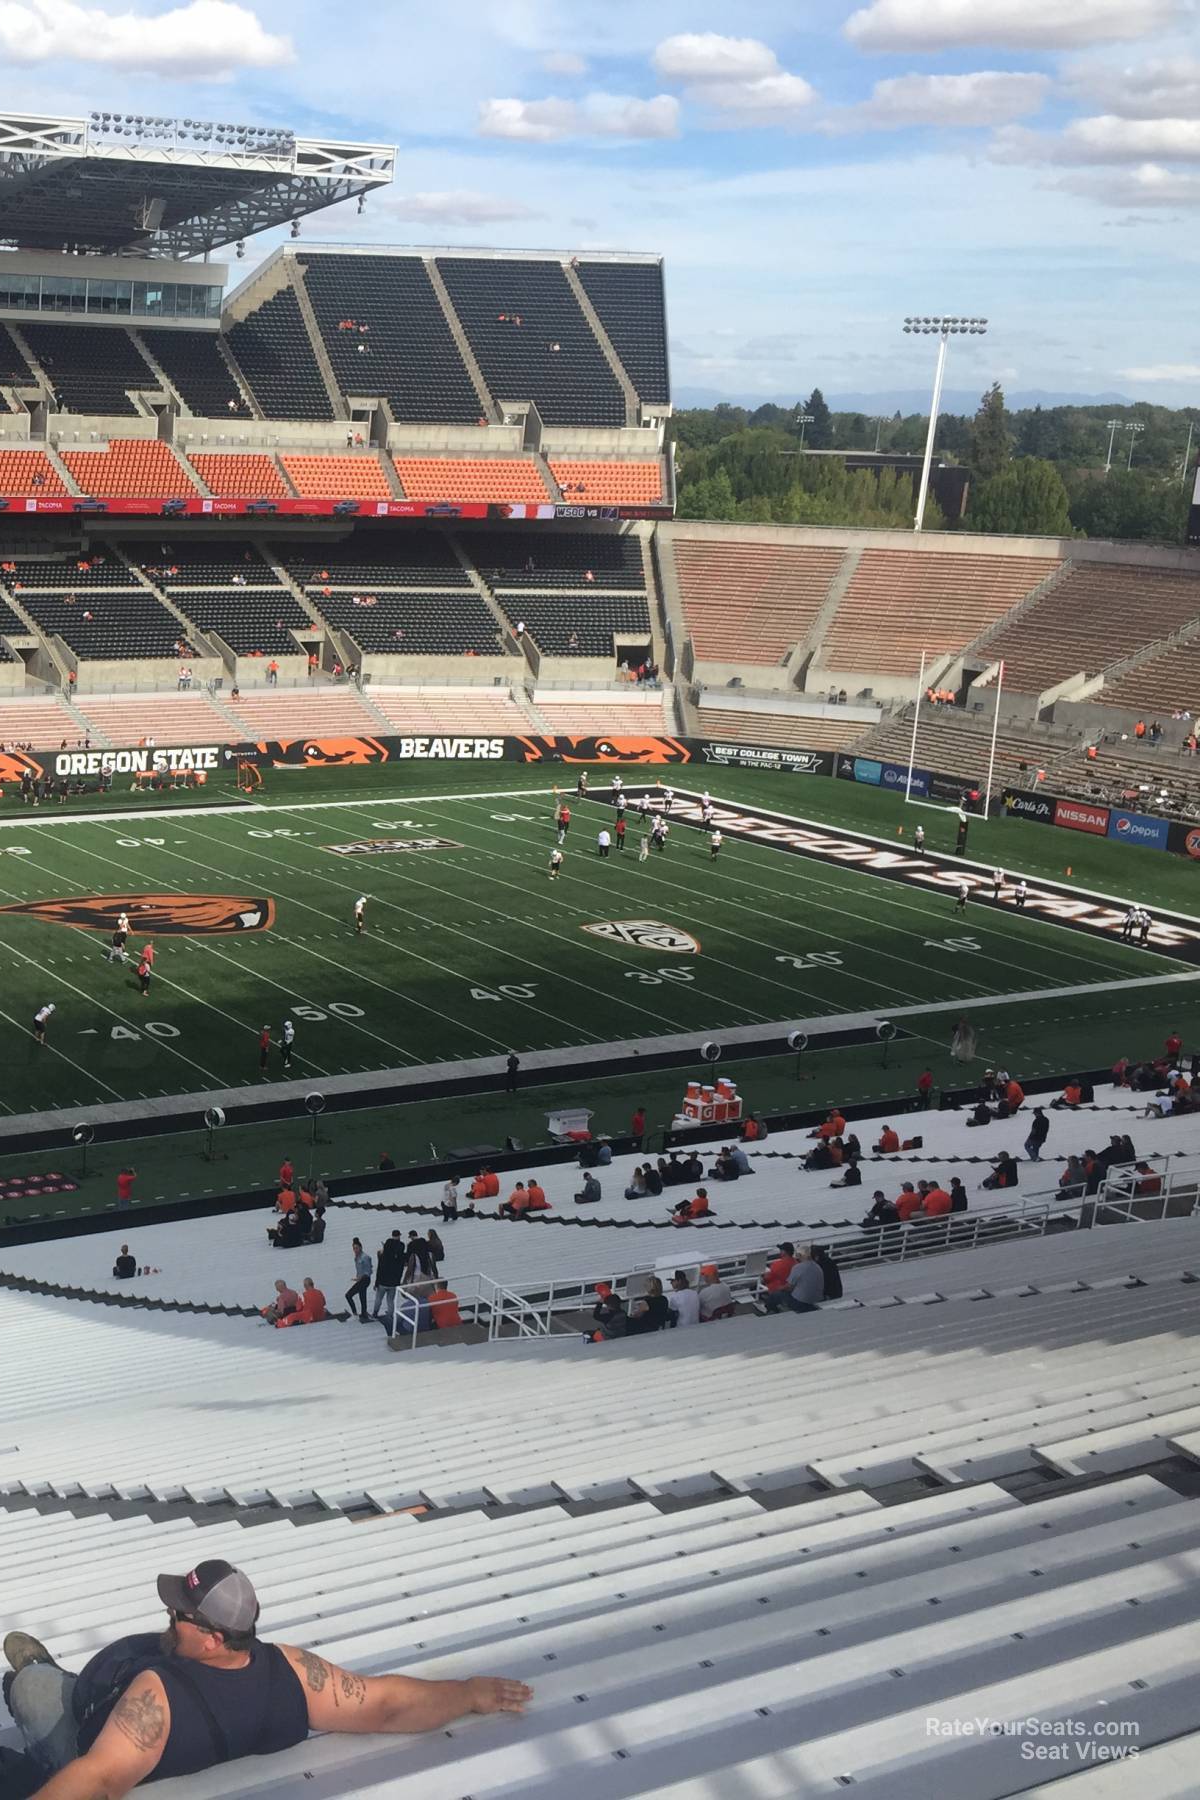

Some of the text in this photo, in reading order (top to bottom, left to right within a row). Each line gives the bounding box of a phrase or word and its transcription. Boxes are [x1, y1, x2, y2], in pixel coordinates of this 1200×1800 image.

[38, 501, 63, 510] TACOMA
[214, 502, 237, 510] TACOMA
[389, 505, 414, 513] TACOMA
[399, 737, 505, 759] BEAVERS
[715, 747, 809, 764] BEST COLLEGE TOWN
[55, 747, 219, 776] OREGON STATE
[1056, 807, 1107, 827] NISSAN
[1130, 825, 1160, 839] pepsi
[627, 796, 1200, 946] OREGON STATE
[921, 939, 982, 952] 10
[775, 952, 844, 969] 20
[624, 968, 695, 985] 30
[469, 985, 536, 1001] 40
[290, 1002, 366, 1021] 50
[110, 1022, 181, 1042] 40
[703, 1106, 714, 1119] G
